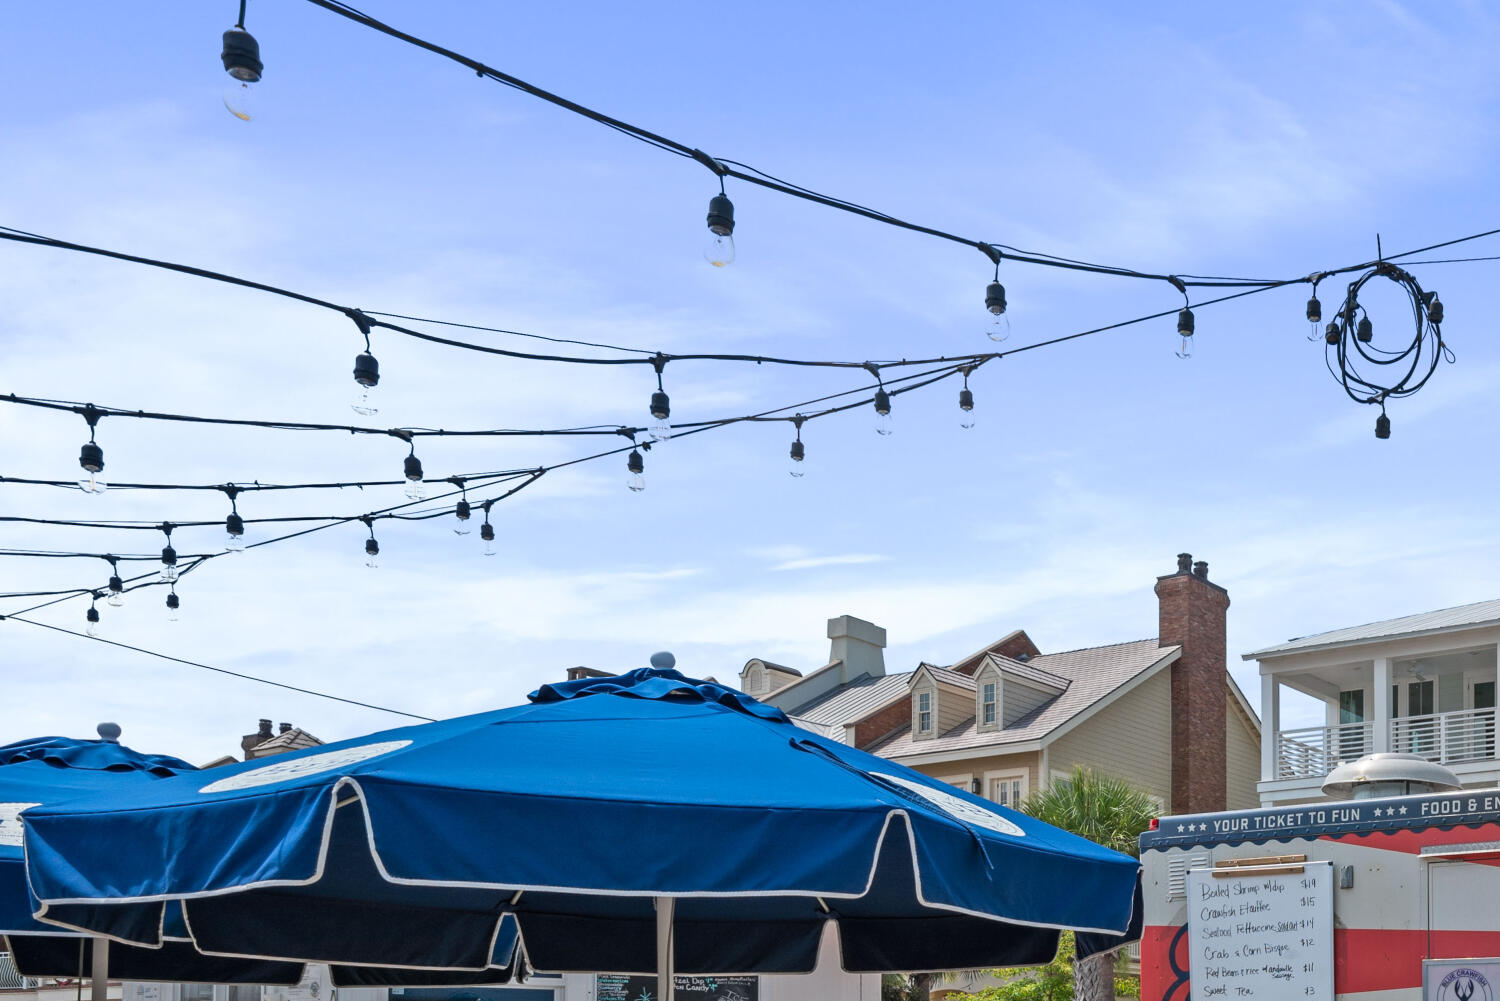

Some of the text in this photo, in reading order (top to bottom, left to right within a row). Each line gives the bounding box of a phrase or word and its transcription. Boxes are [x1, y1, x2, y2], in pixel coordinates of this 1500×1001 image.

[1421, 800, 1461, 815] FOOD
[1468, 799, 1478, 812] &
[1214, 808, 1360, 832] YOUR TICKET TO FUN
[1201, 883, 1230, 900] Boiled
[1234, 882, 1259, 896] Shrimp
[1201, 906, 1236, 920] Crawfish
[1300, 897, 1315, 907] $15
[1202, 927, 1231, 939] Seafood
[1300, 918, 1314, 928] $14
[1204, 947, 1229, 960] Crab
[1243, 944, 1262, 957] Corn
[1264, 943, 1290, 956] Bisque
[1300, 939, 1315, 947] $12
[1205, 966, 1219, 979] Red
[1303, 963, 1314, 973] $11
[1441, 970, 1487, 987] BLUE CRAWFISH
[1203, 984, 1315, 997] Sweet Tea $3
